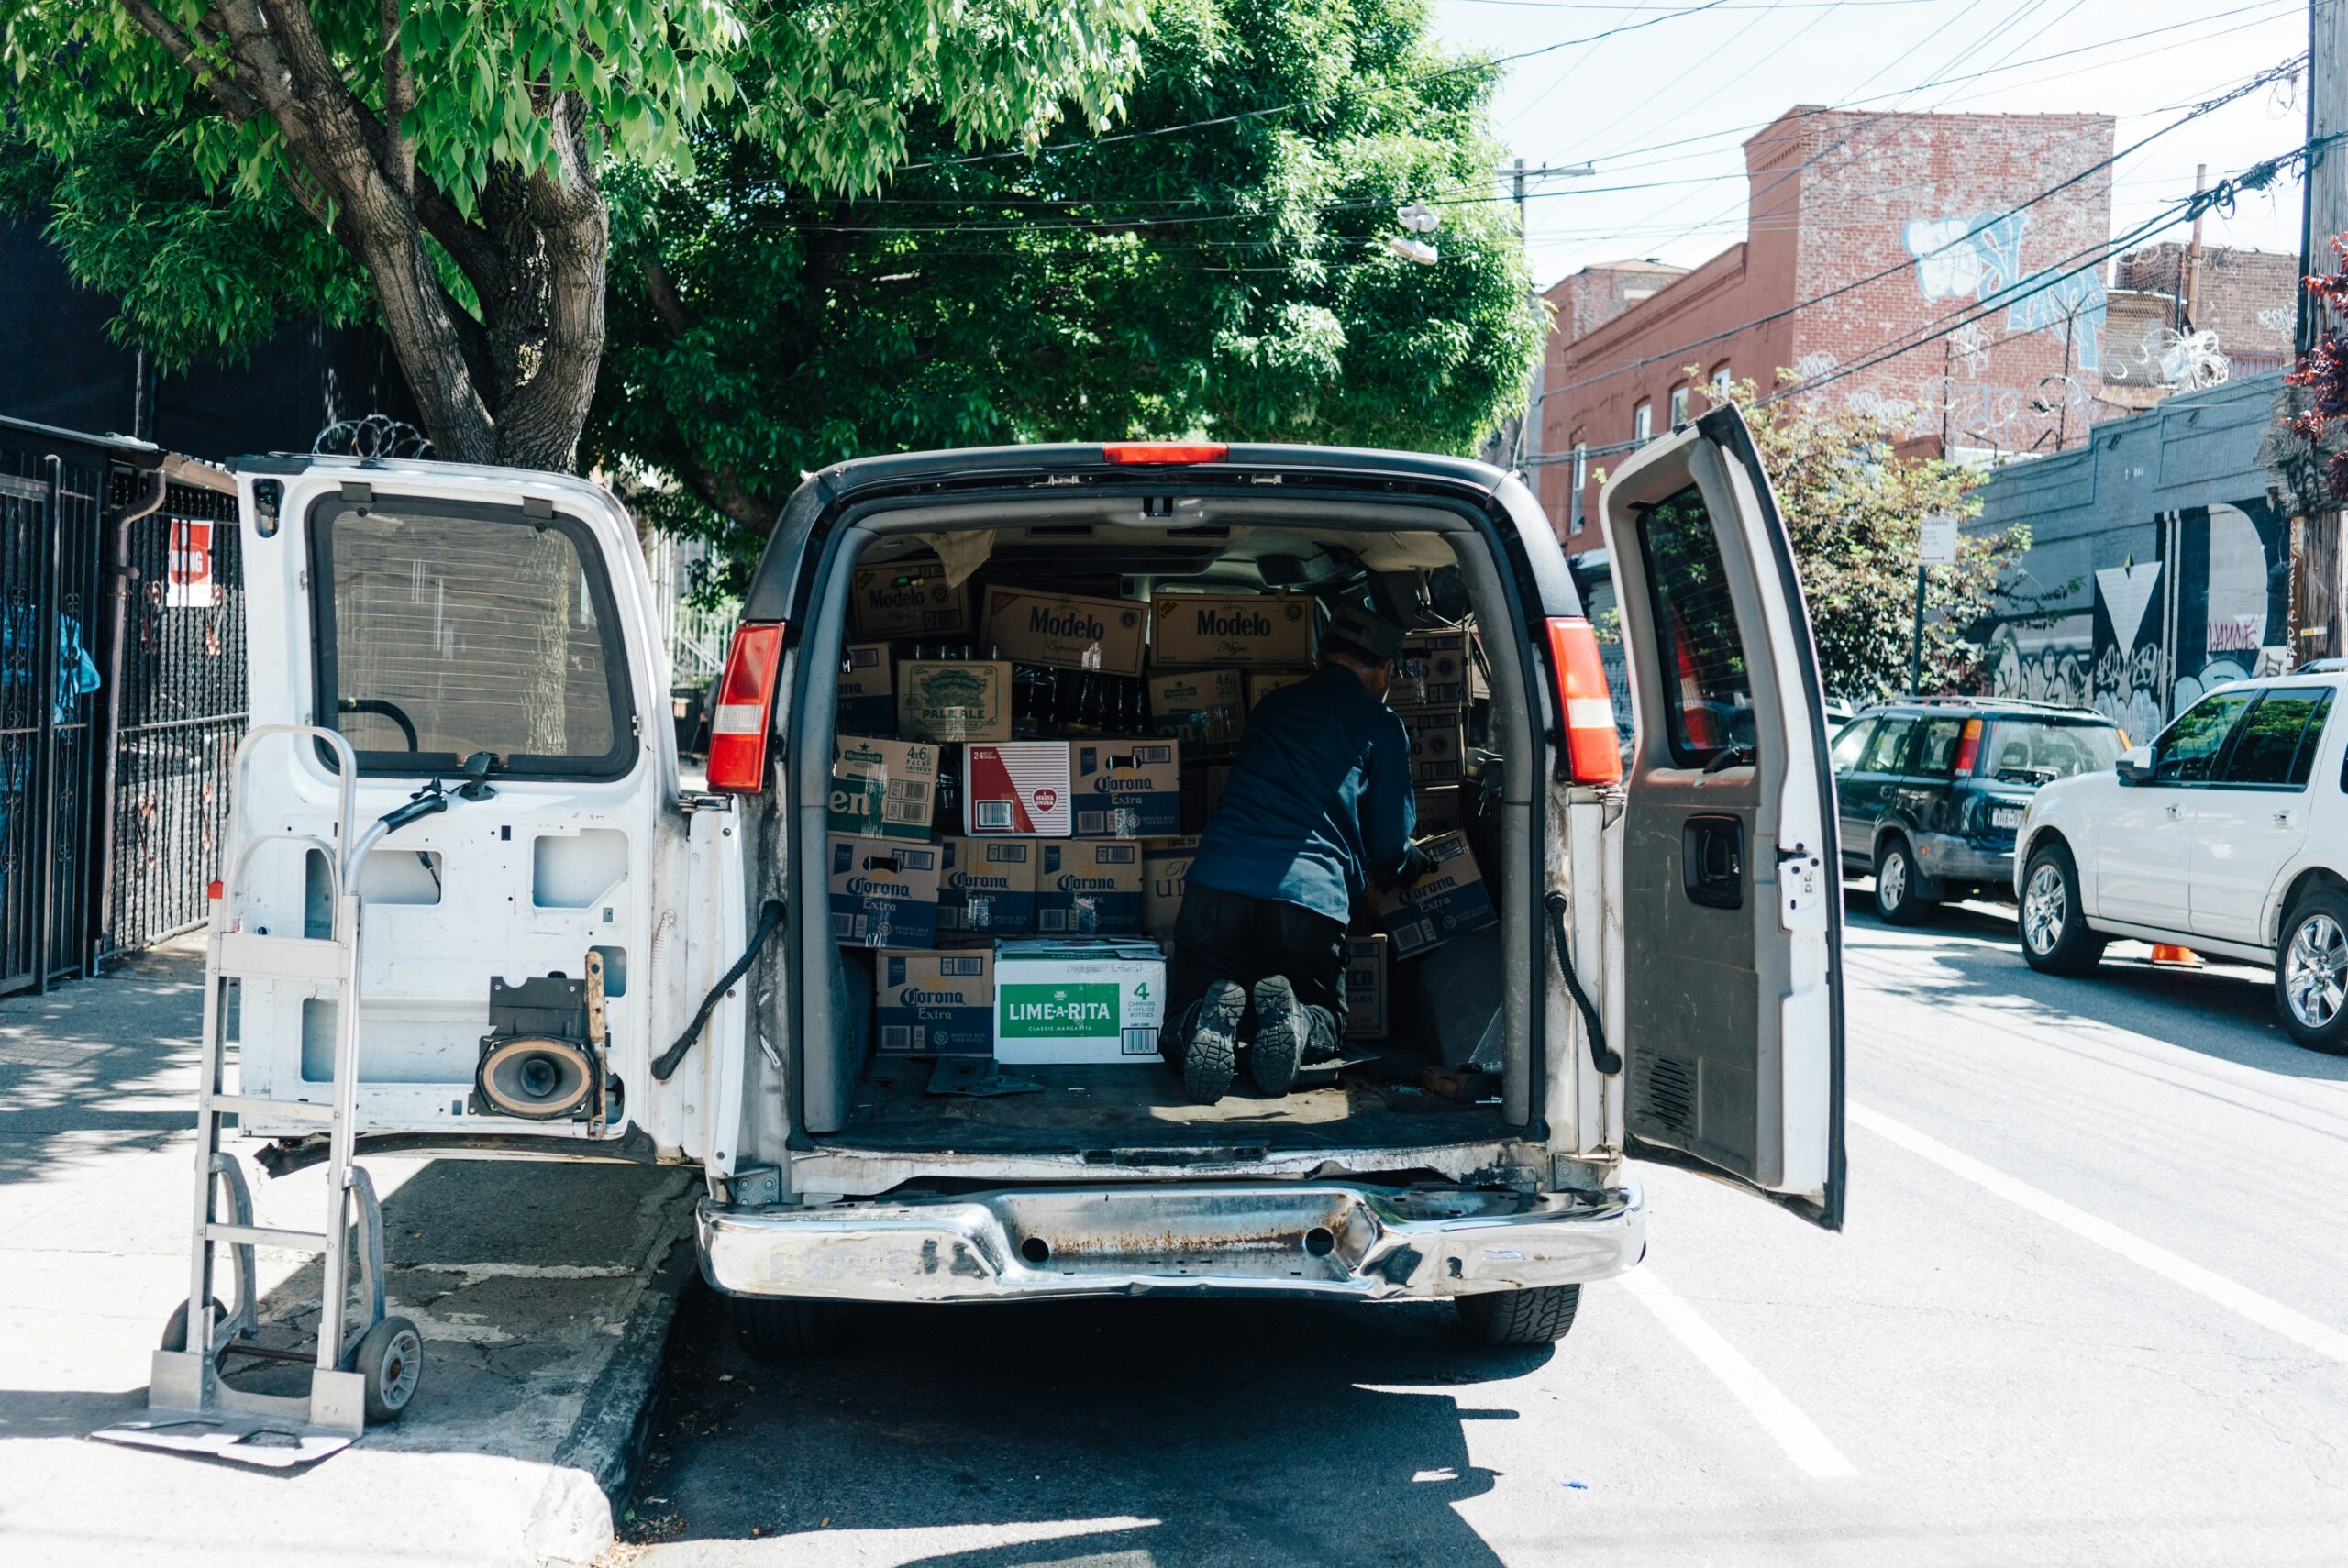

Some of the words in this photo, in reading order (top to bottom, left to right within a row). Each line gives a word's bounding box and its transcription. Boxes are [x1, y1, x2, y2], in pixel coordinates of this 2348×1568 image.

[172, 550, 203, 572] PAKNG
[869, 588, 925, 609] Modelo
[1029, 606, 1104, 641] Modelo
[1197, 609, 1271, 636] Modelo
[1217, 641, 1249, 657] Negra
[923, 709, 954, 719] PALE
[960, 709, 985, 719] ALE
[846, 752, 881, 762] Heineken
[906, 745, 927, 760] 4x6
[973, 751, 984, 760] 24
[1094, 776, 1154, 793] Corona
[1111, 793, 1143, 805] Extra
[846, 876, 910, 897] Corona
[948, 871, 1008, 890] Corona
[1057, 874, 1115, 891] Corona
[1399, 875, 1455, 906] Corona
[863, 897, 896, 911] Extra
[1418, 895, 1452, 913] Extra
[900, 987, 964, 1007] Corona
[1134, 982, 1150, 1000] 4
[918, 1008, 953, 1020] Extra
